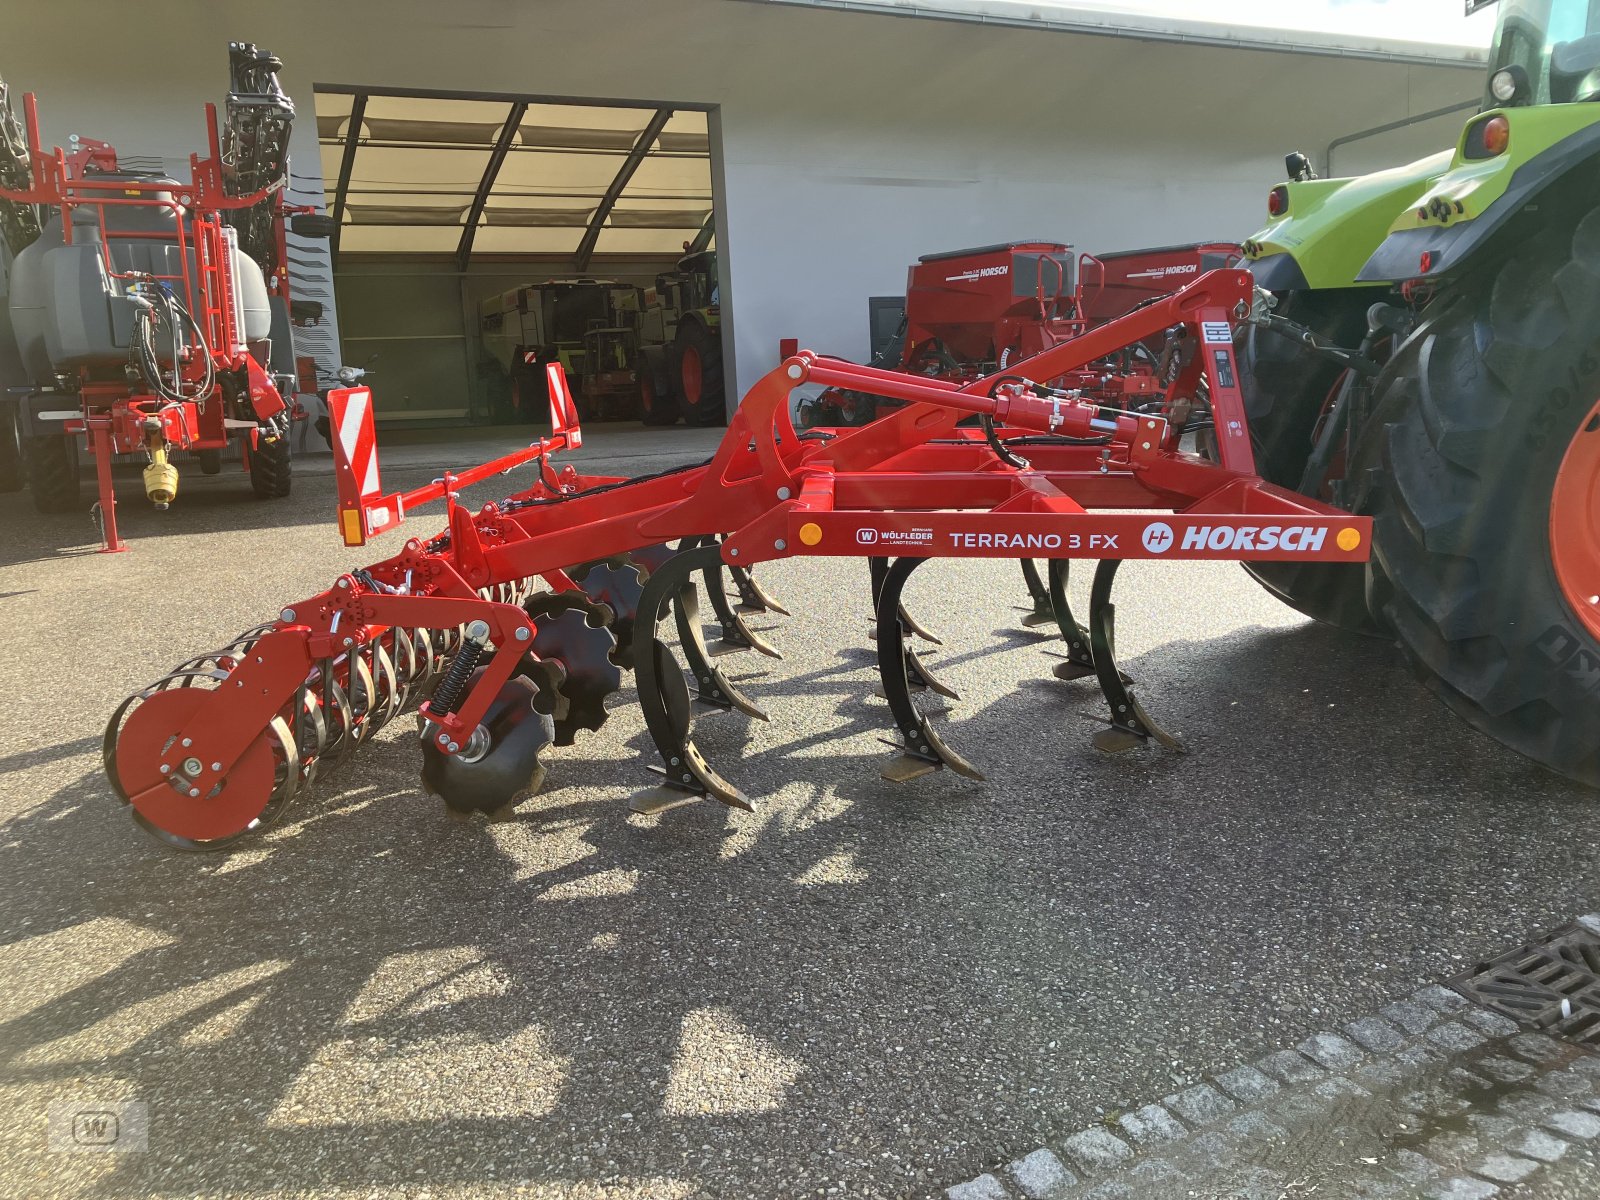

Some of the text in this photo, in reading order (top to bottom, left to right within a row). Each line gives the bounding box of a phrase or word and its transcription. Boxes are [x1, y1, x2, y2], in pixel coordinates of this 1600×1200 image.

[980, 265, 1009, 277] HORSCH
[1165, 264, 1197, 275] HORSCH
[881, 530, 933, 540] WÖLFLEDER
[949, 533, 1119, 549] TERRANO 3 FX
[1180, 525, 1328, 551] HORSCH
